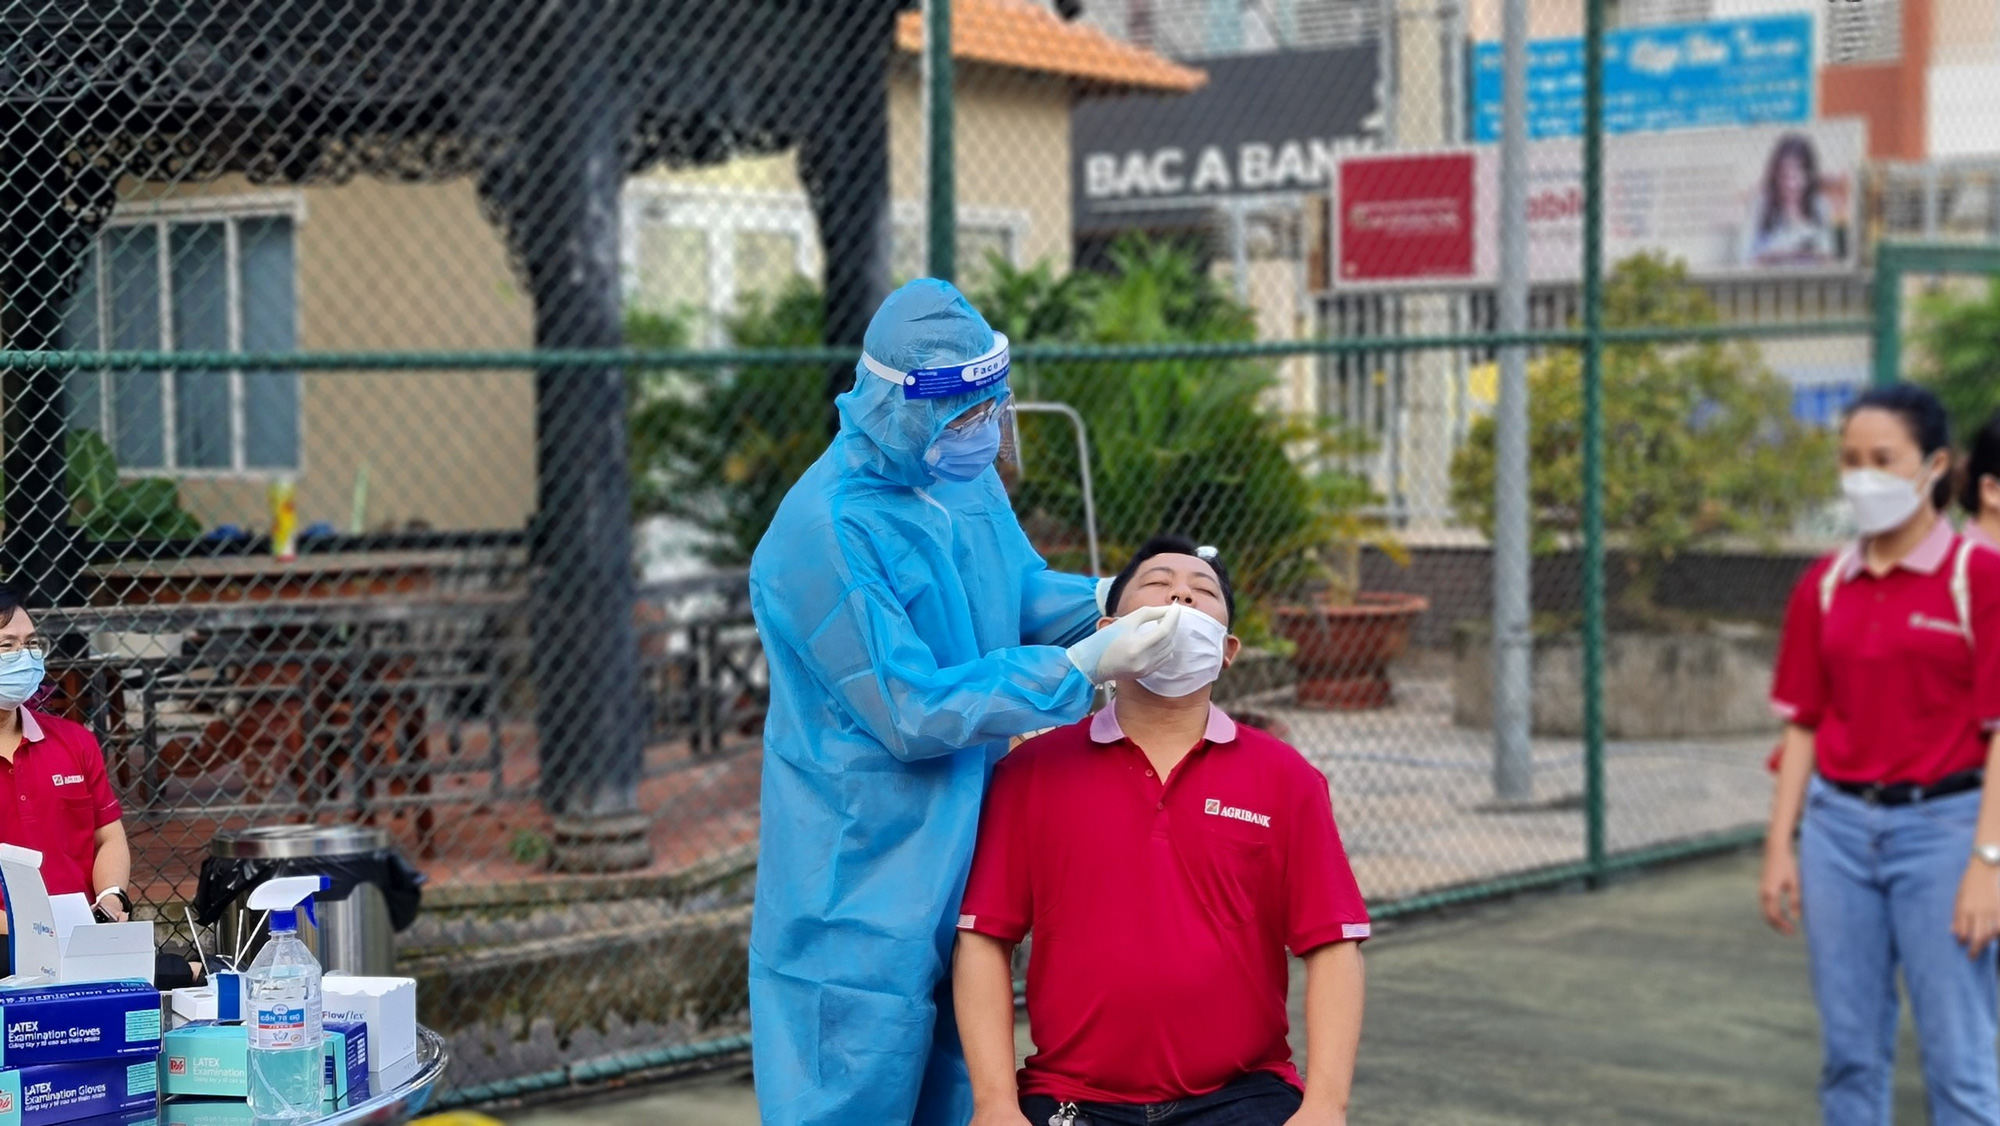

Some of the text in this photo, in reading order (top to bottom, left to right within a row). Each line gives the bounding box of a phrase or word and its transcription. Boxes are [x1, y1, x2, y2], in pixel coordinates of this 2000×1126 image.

[1085, 147, 1184, 197] BAC
[1193, 146, 1231, 190] A
[972, 362, 998, 377] Face
[1220, 806, 1271, 828] AGRIBANK
[322, 1010, 365, 1021] Flowflex
[8, 1021, 38, 1033] LATEX
[8, 1027, 100, 1043] Examination Gloves
[193, 1057, 220, 1067] LATEX
[193, 1066, 245, 1077] Examination
[24, 1082, 51, 1096] LATEX
[25, 1089, 77, 1105] Examination
[78, 1084, 106, 1096] Gloves
